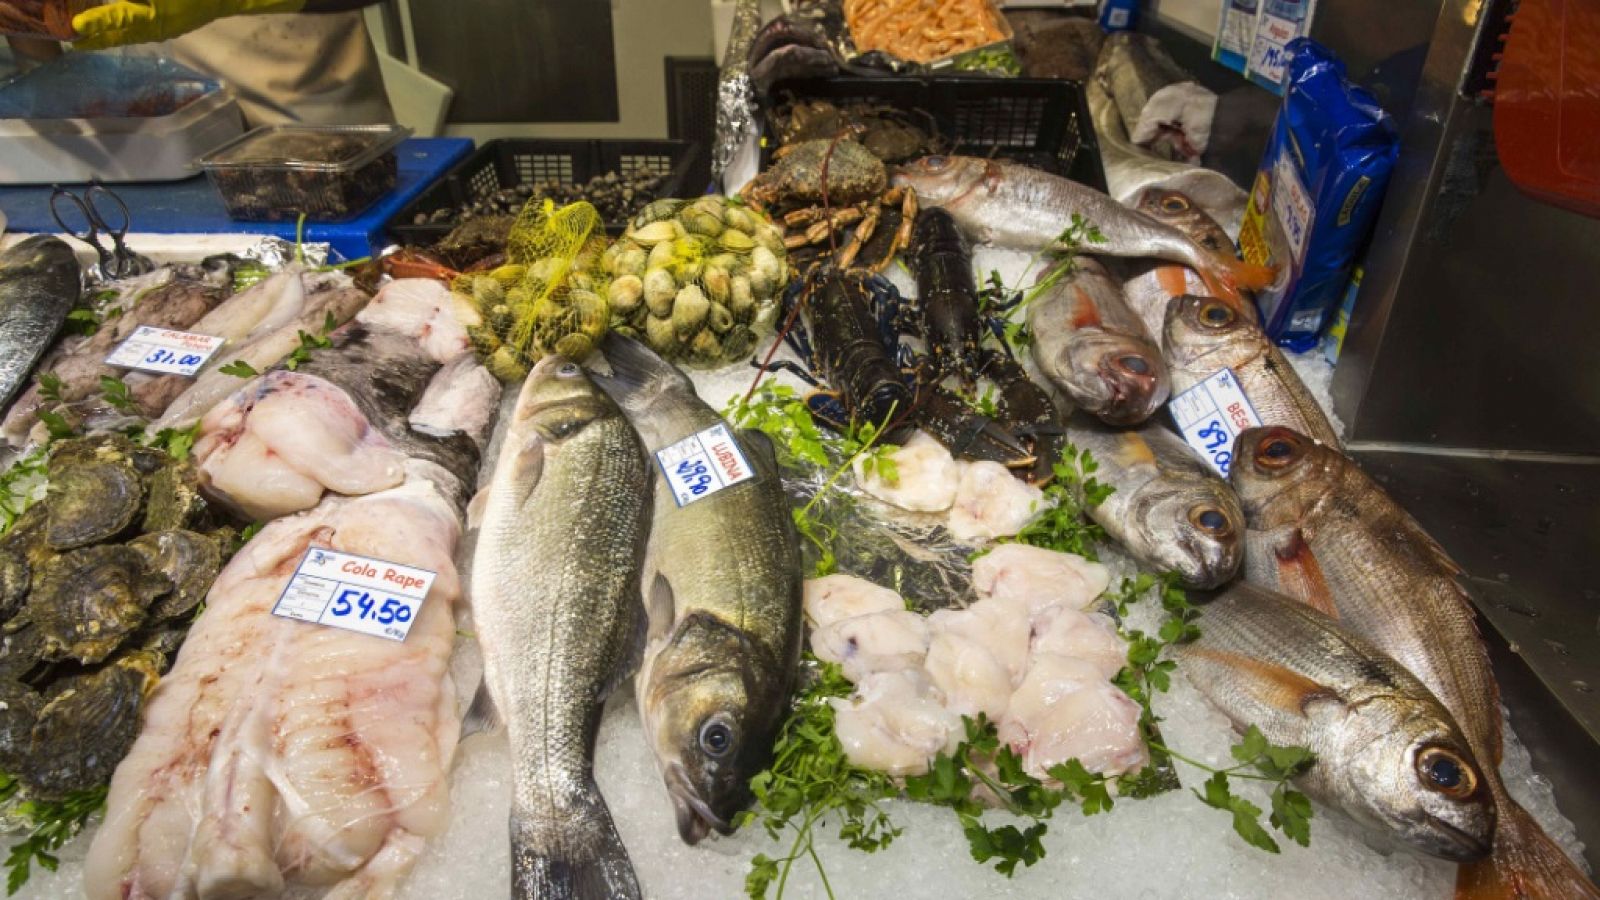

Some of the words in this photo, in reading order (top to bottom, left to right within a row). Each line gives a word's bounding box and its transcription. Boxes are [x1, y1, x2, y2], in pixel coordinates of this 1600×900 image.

[712, 441, 743, 480] LUBINA
[341, 560, 377, 578] Cola
[383, 568, 426, 590] Rape
